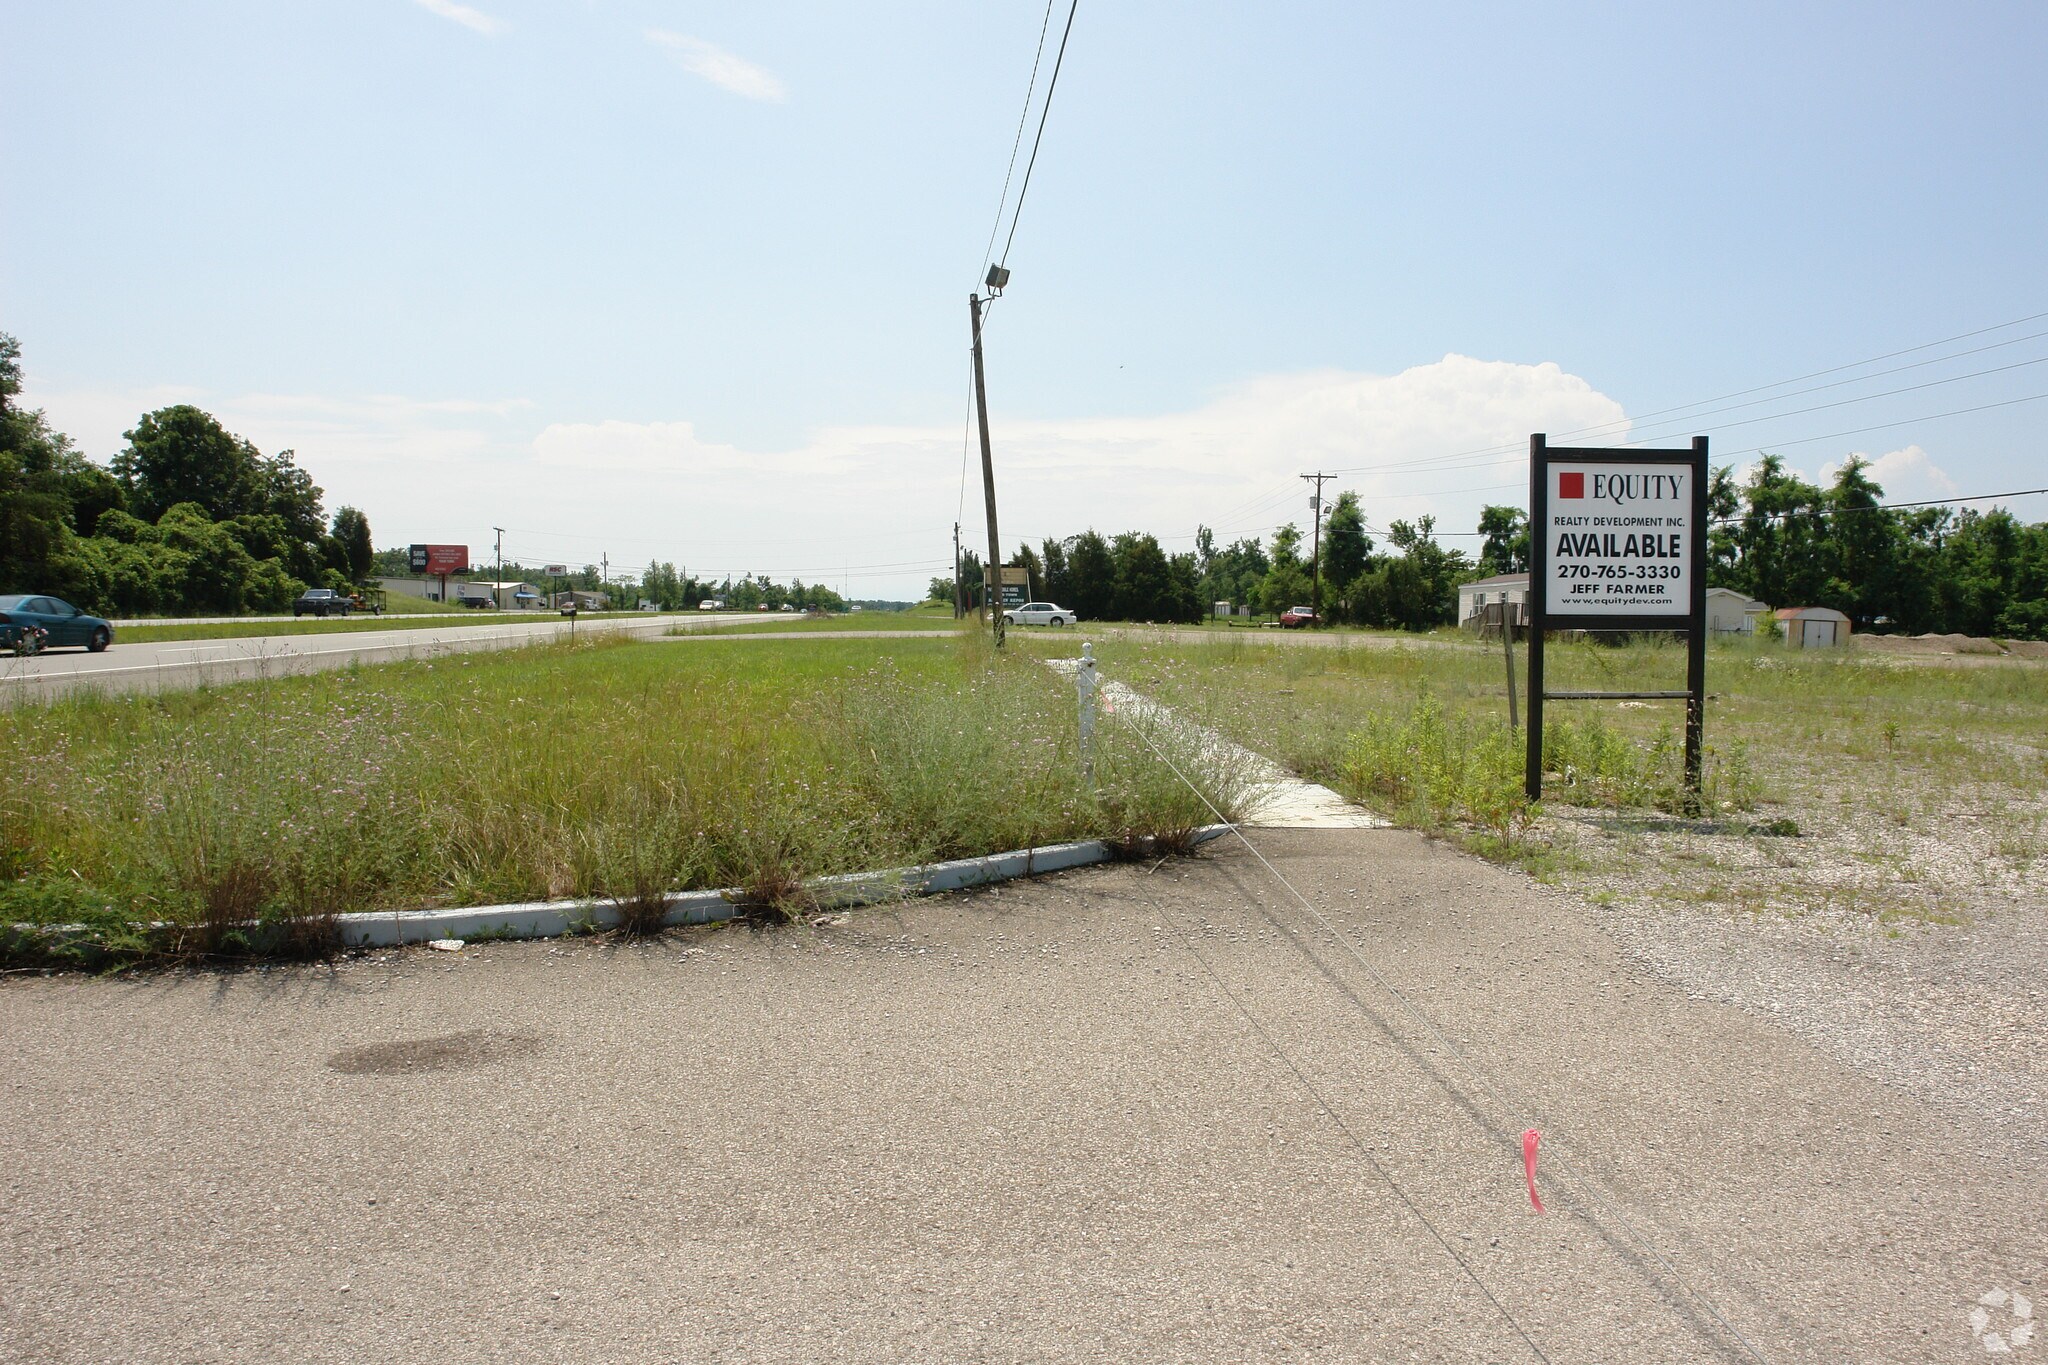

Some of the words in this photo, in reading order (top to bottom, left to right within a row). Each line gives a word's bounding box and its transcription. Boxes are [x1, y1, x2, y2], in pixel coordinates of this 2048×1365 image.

[1592, 474, 1684, 505] EQUITY
[1554, 516, 1590, 526] REALTY
[1593, 517, 1663, 527] DEVELOPMENT
[1666, 518, 1686, 527] INC.
[1556, 533, 1681, 558] AVAILABLE
[1557, 565, 1681, 579] 270-765-3330
[1570, 584, 1600, 594] JEFF
[1606, 584, 1665, 594] FARMER
